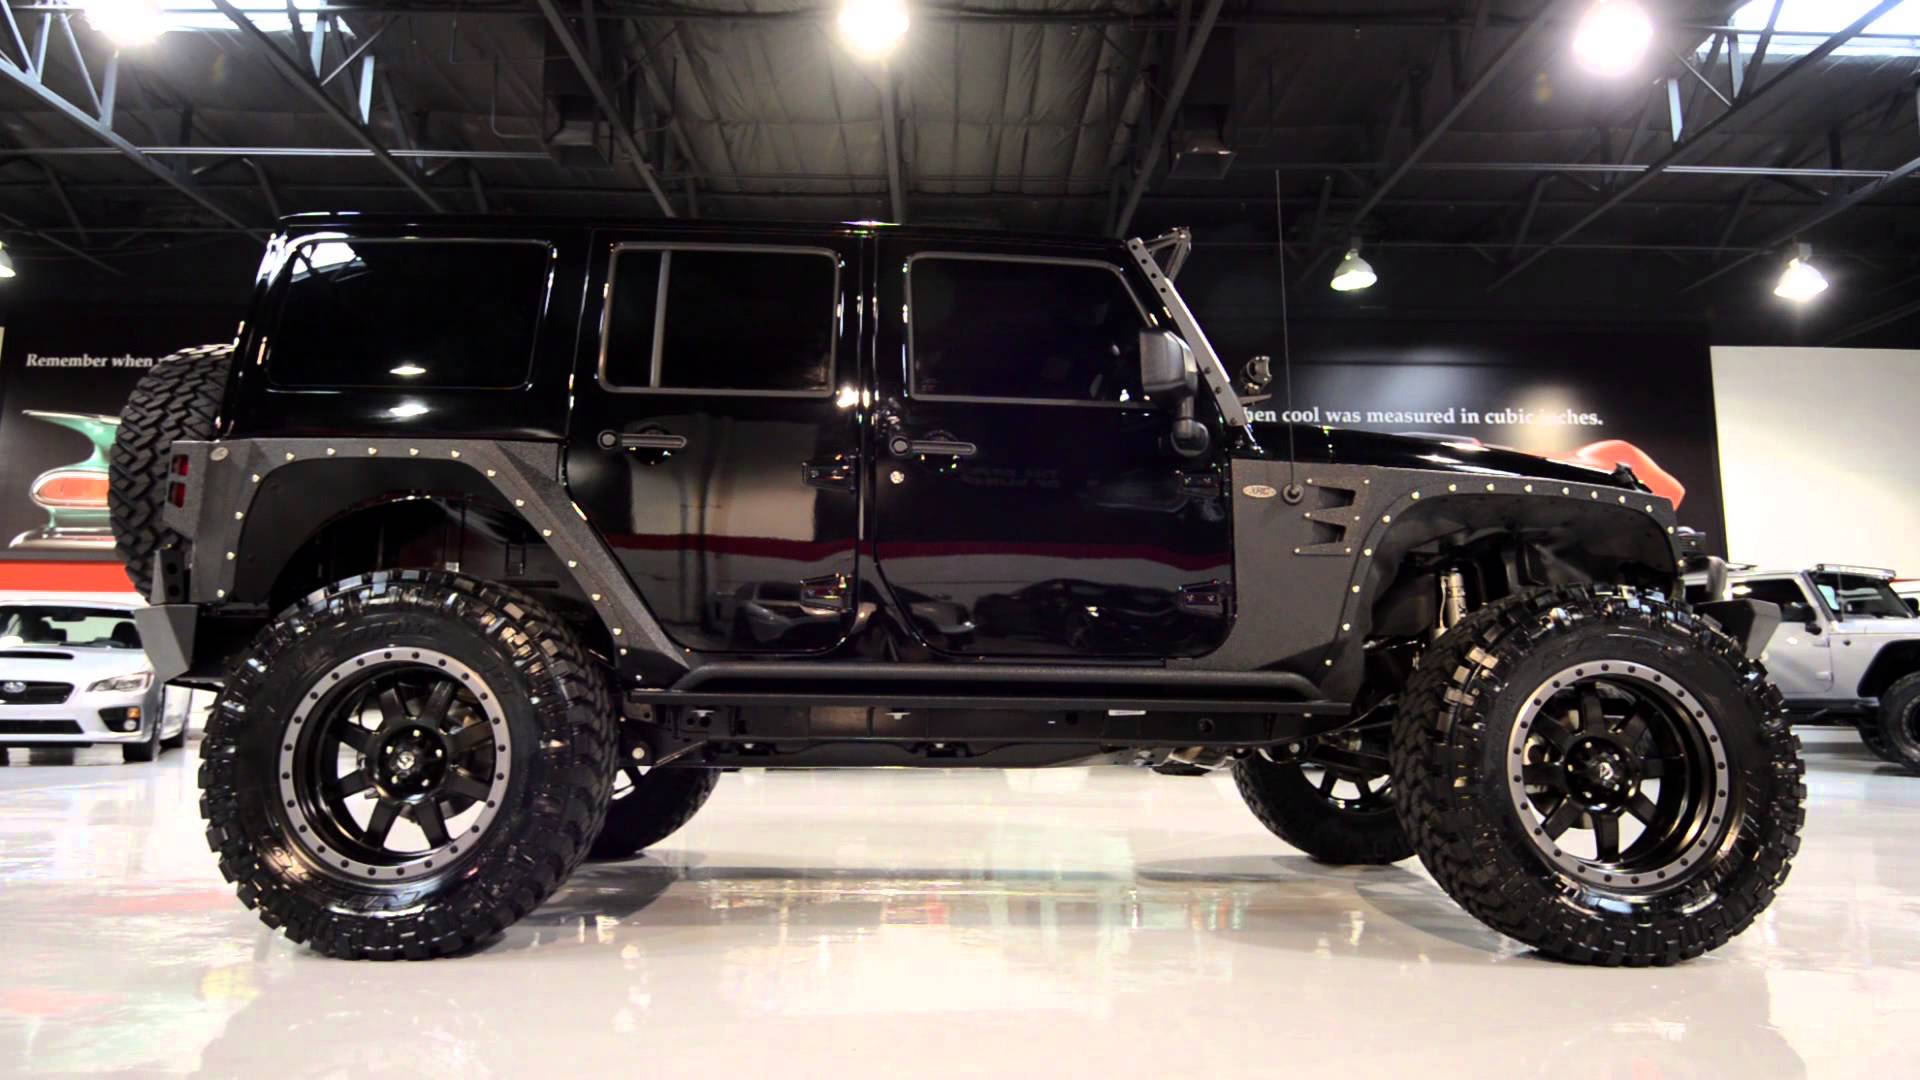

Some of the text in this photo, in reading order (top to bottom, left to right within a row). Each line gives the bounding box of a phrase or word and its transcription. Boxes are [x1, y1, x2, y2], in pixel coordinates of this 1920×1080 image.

[26, 353, 107, 368] Remember
[111, 354, 153, 368] when
[1281, 406, 1321, 423] cool
[1325, 410, 1362, 424] was
[1366, 407, 1456, 425] measured
[1460, 407, 1481, 425] in
[1484, 408, 1534, 425] cubic
[1538, 408, 1604, 426] ches.
